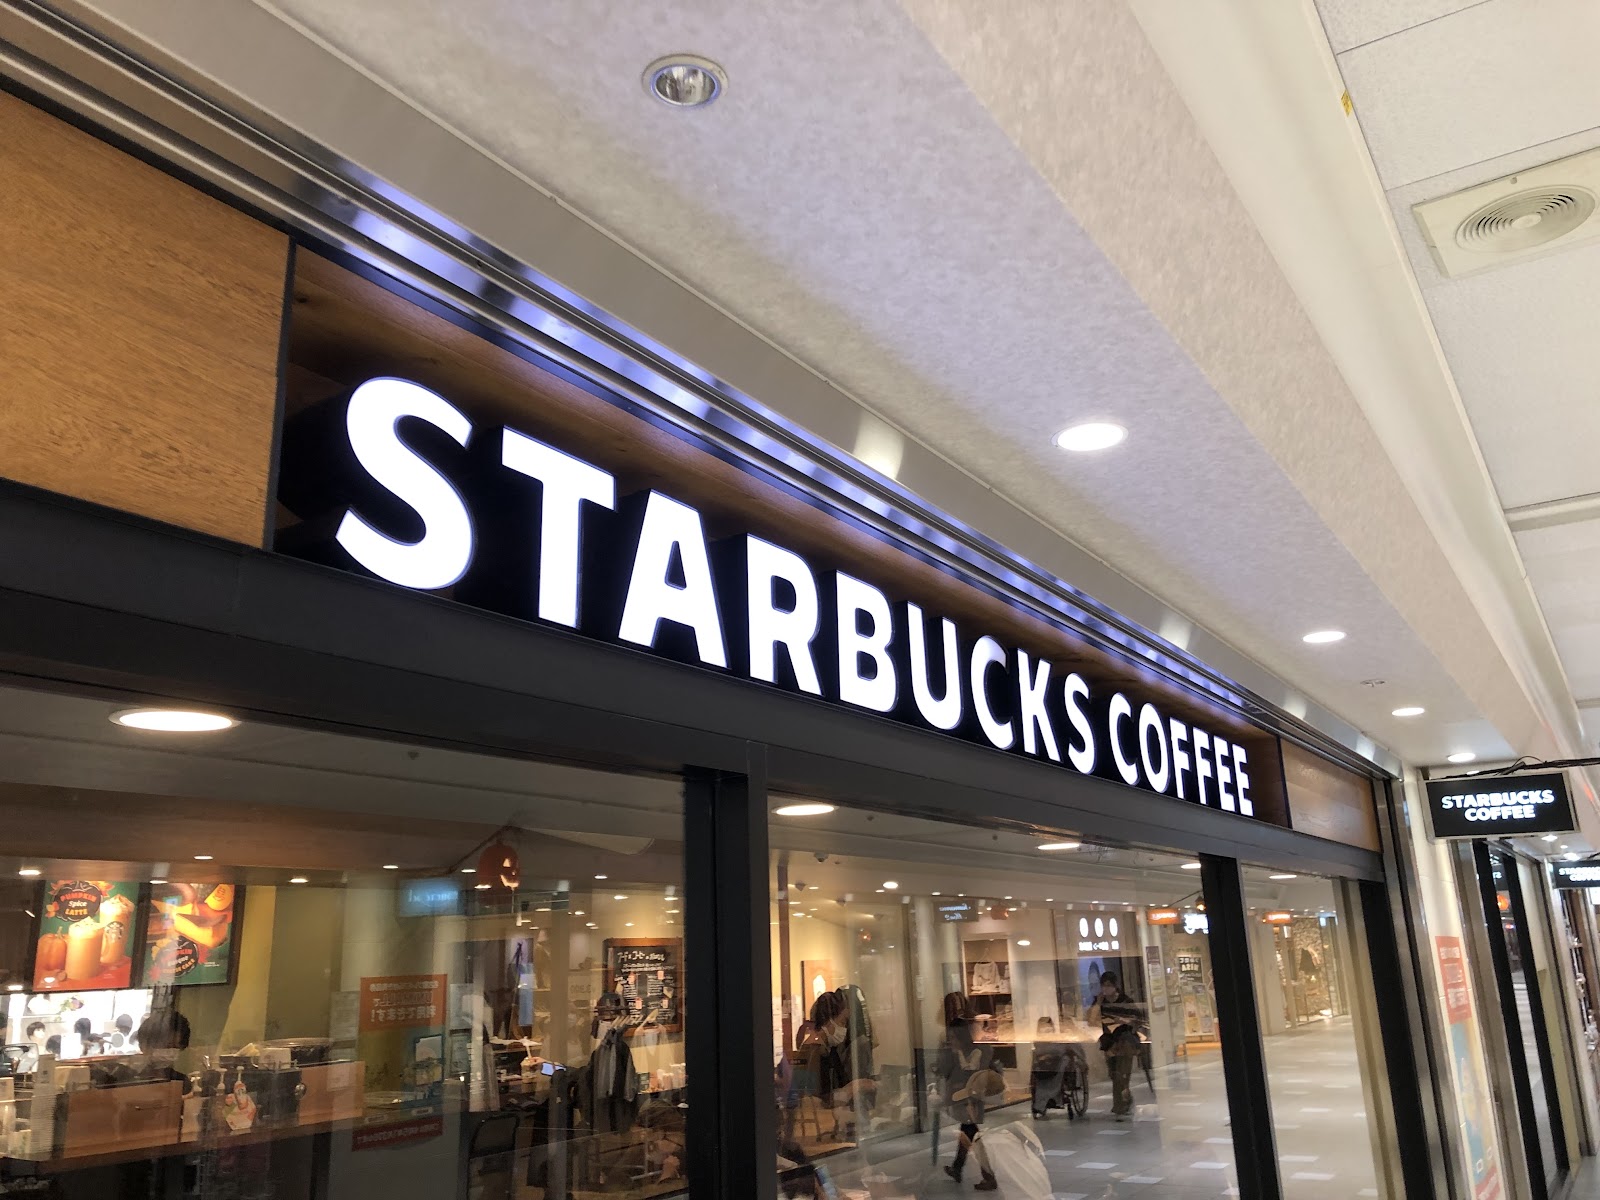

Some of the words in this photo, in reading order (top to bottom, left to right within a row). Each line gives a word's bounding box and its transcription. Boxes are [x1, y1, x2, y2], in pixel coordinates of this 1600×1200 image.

[336, 377, 1096, 775] STARBUCKS
[1109, 692, 1254, 817] COFFEE
[1441, 790, 1555, 809] STARBUCKS
[1464, 804, 1536, 821] COFFEE
[60, 891, 97, 903] PUMPKIN
[67, 899, 88, 908] Spice
[64, 908, 88, 916] LATTE
